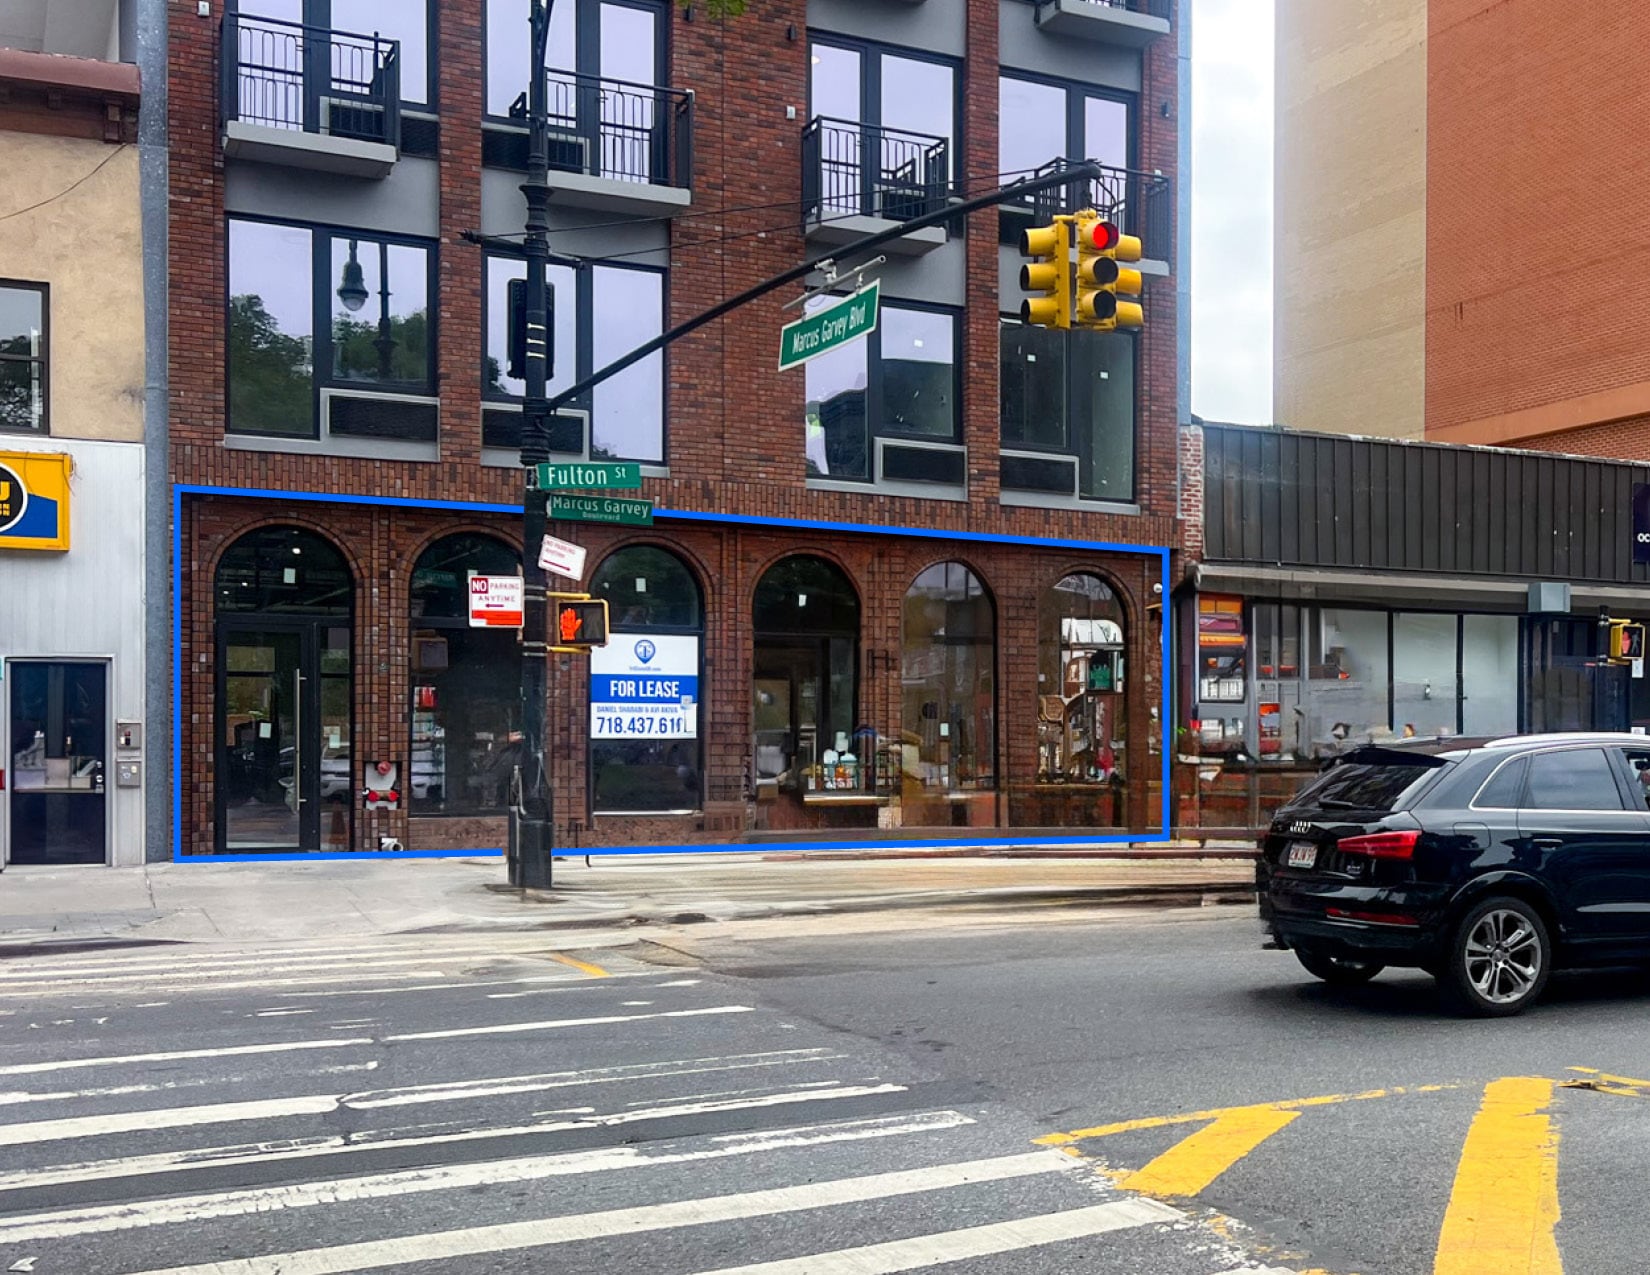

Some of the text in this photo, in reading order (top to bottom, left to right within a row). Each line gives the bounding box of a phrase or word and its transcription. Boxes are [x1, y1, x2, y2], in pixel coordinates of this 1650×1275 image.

[792, 301, 866, 354] Marcus Garvey Blvd
[547, 465, 627, 485] Fulton St
[553, 496, 649, 518] Marcus Garvey
[471, 579, 520, 592] NO PARKING
[478, 594, 516, 603] ANYTIME
[610, 680, 680, 698] FOR LEASE
